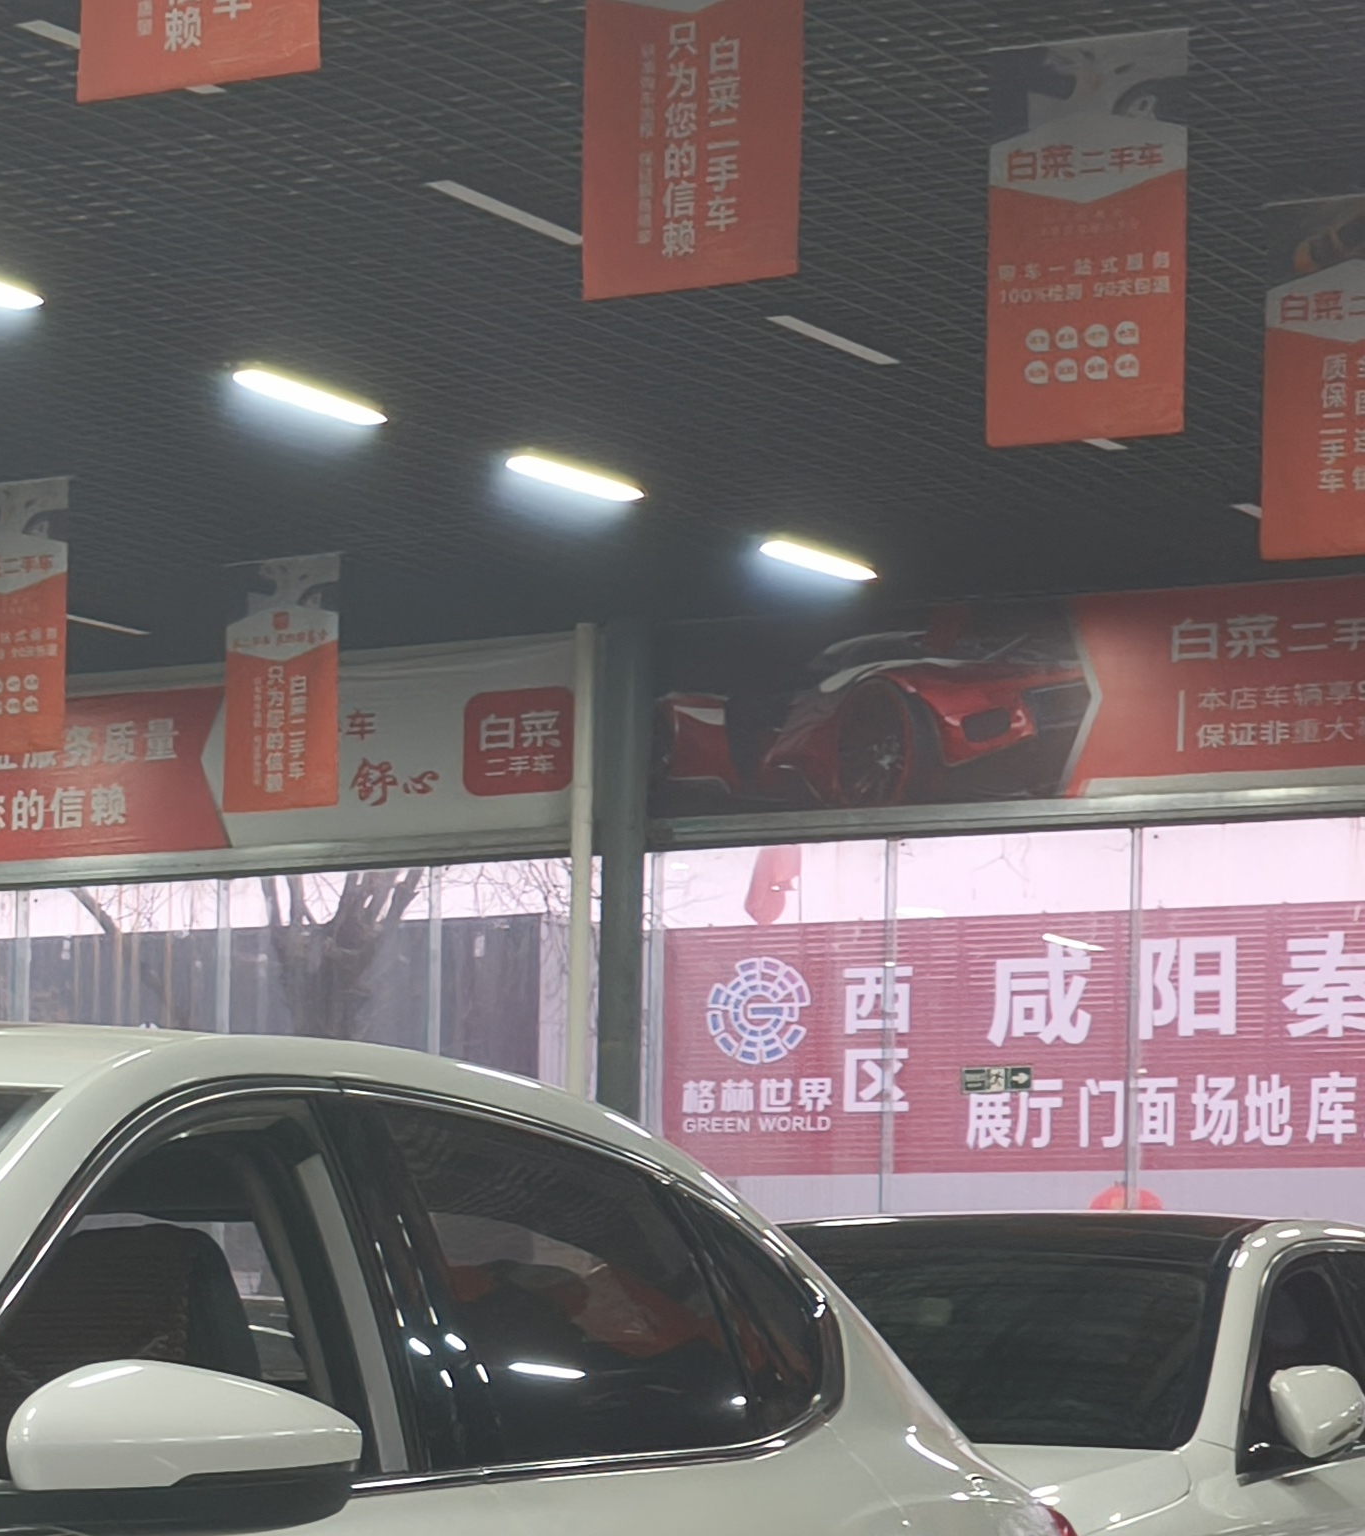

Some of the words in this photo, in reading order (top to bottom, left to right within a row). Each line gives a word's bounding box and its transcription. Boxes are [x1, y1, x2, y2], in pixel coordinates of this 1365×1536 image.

[163, 0, 201, 51] 赖
[662, 20, 698, 258] 只为您的信赖
[705, 37, 741, 232] 白菜二手车
[1006, 143, 1165, 182] 白菜二手车
[1317, 352, 1348, 492] 质保二手车
[479, 711, 562, 751] 白菜
[485, 754, 556, 776] 二手车
[986, 931, 1365, 1047] 咸阳秦
[682, 1078, 832, 1114] 格林世界
[682, 1117, 751, 1133] GREEN
[759, 1116, 831, 1132] WORLD
